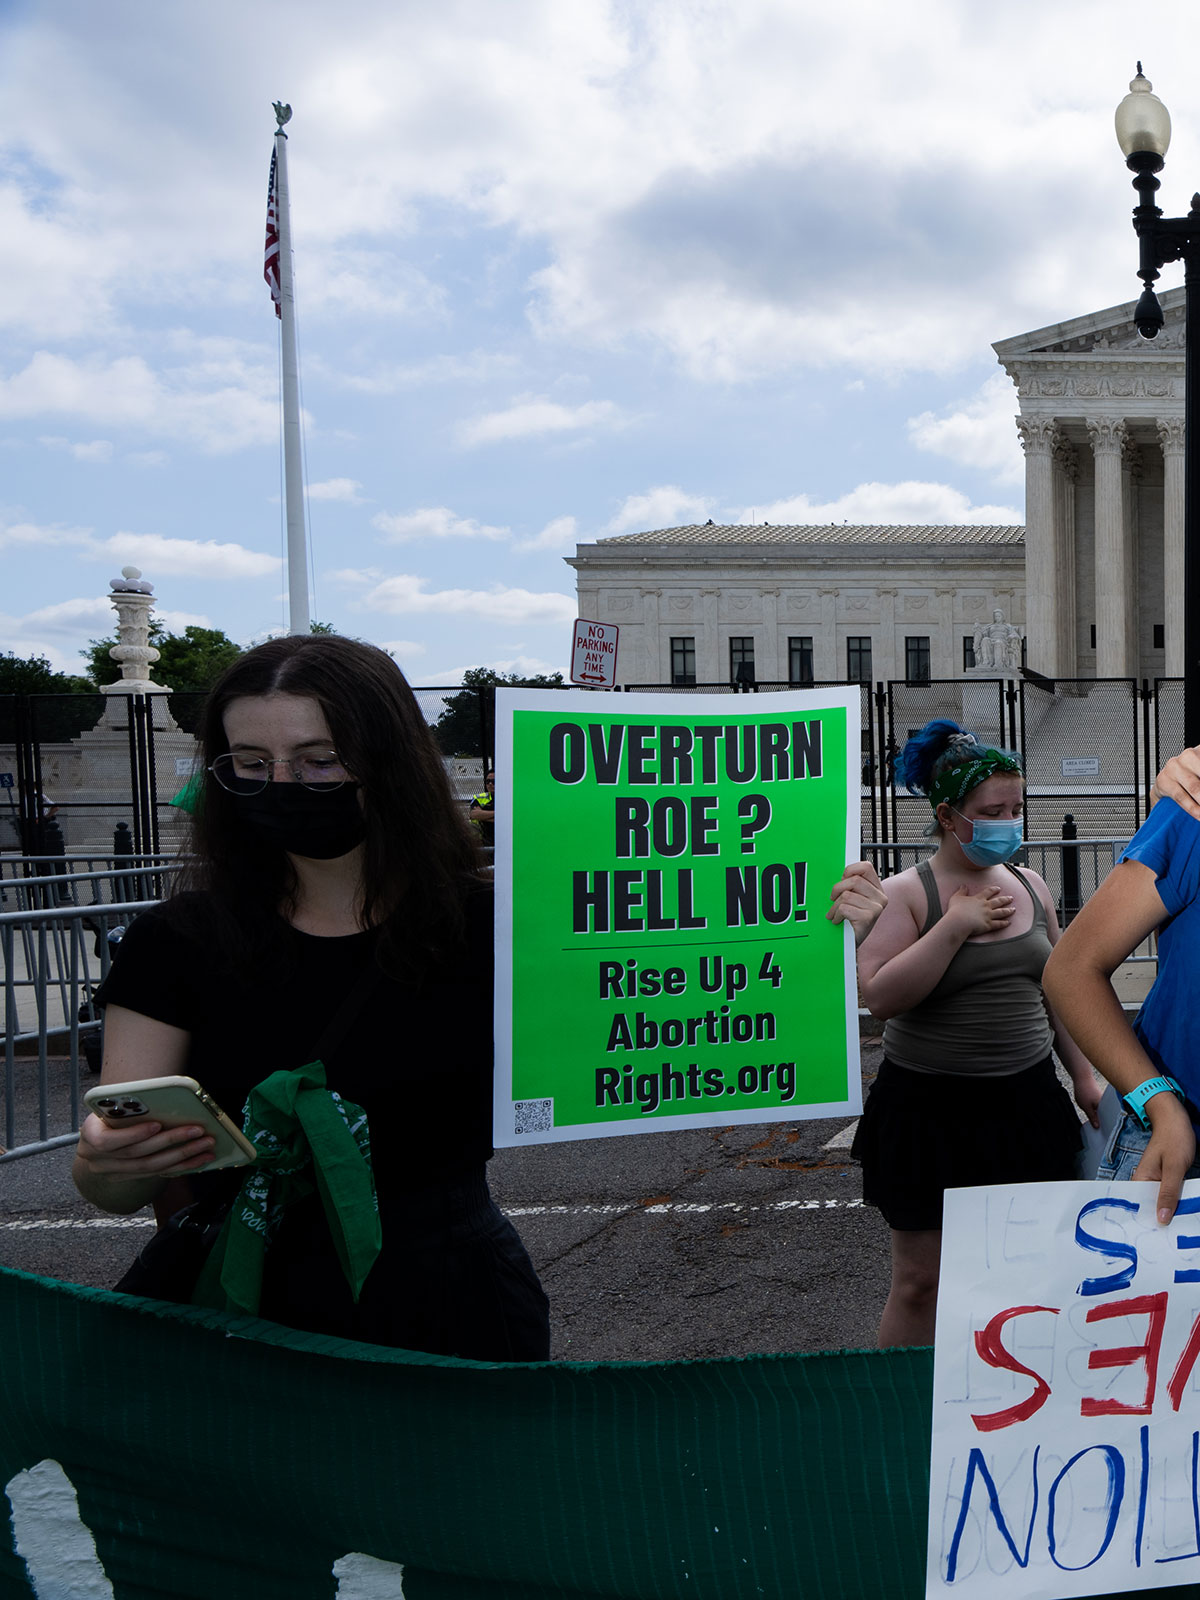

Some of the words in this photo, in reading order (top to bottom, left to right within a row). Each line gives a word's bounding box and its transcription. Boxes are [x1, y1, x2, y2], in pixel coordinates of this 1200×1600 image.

[576, 637, 614, 654] PARKING
[588, 625, 605, 639] NO
[584, 661, 605, 674] TIME
[585, 652, 605, 663] ANY
[548, 719, 824, 786] OVERTURN
[615, 796, 721, 858] ROE
[737, 793, 772, 854] ?
[572, 868, 708, 934] HELL
[725, 861, 809, 928] NO!
[599, 958, 687, 1000] Rise
[698, 955, 748, 1000] Up
[758, 951, 783, 989] 4
[605, 1004, 777, 1053] Abortion
[594, 1060, 798, 1113] Rights.org
